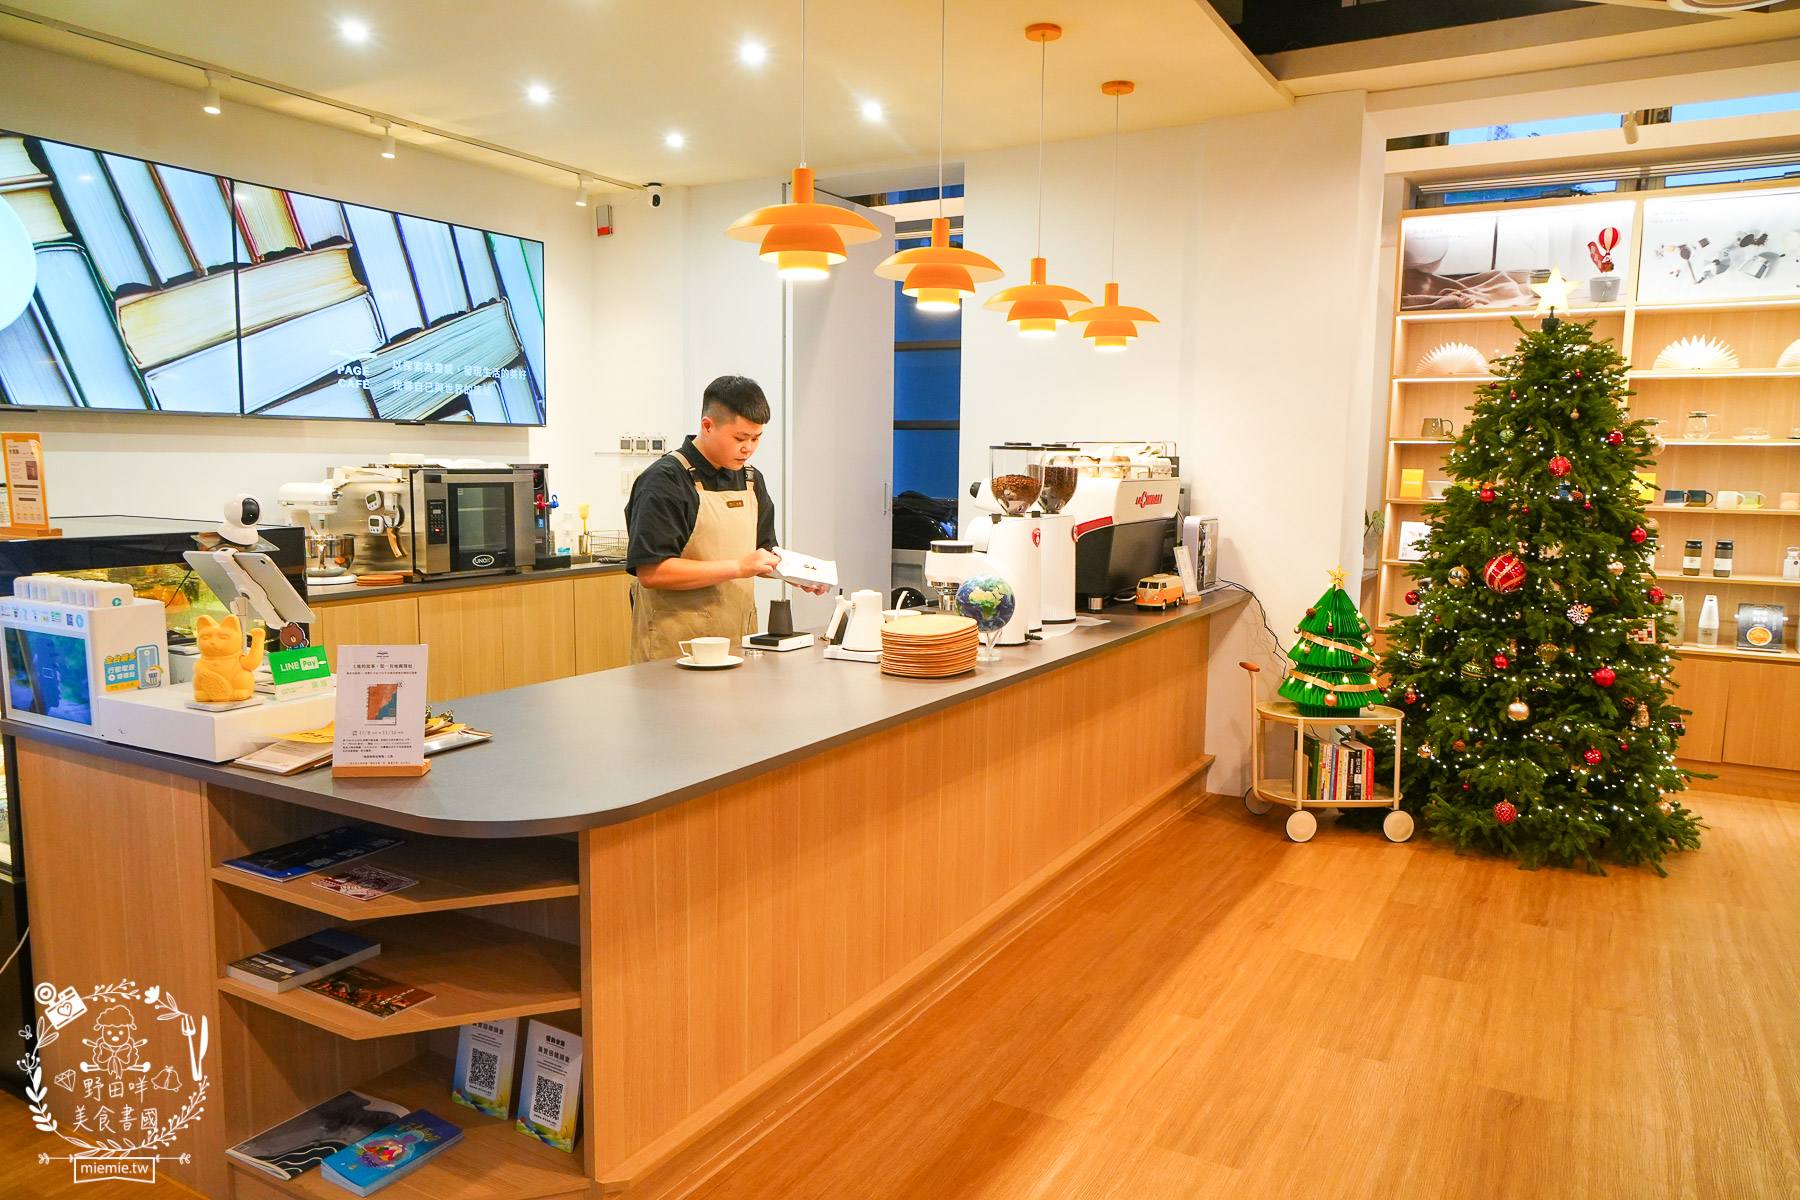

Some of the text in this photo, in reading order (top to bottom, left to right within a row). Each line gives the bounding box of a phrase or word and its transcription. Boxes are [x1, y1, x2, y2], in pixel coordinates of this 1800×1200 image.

[337, 365, 370, 377] PAGE
[280, 660, 316, 672] LINE Pay
